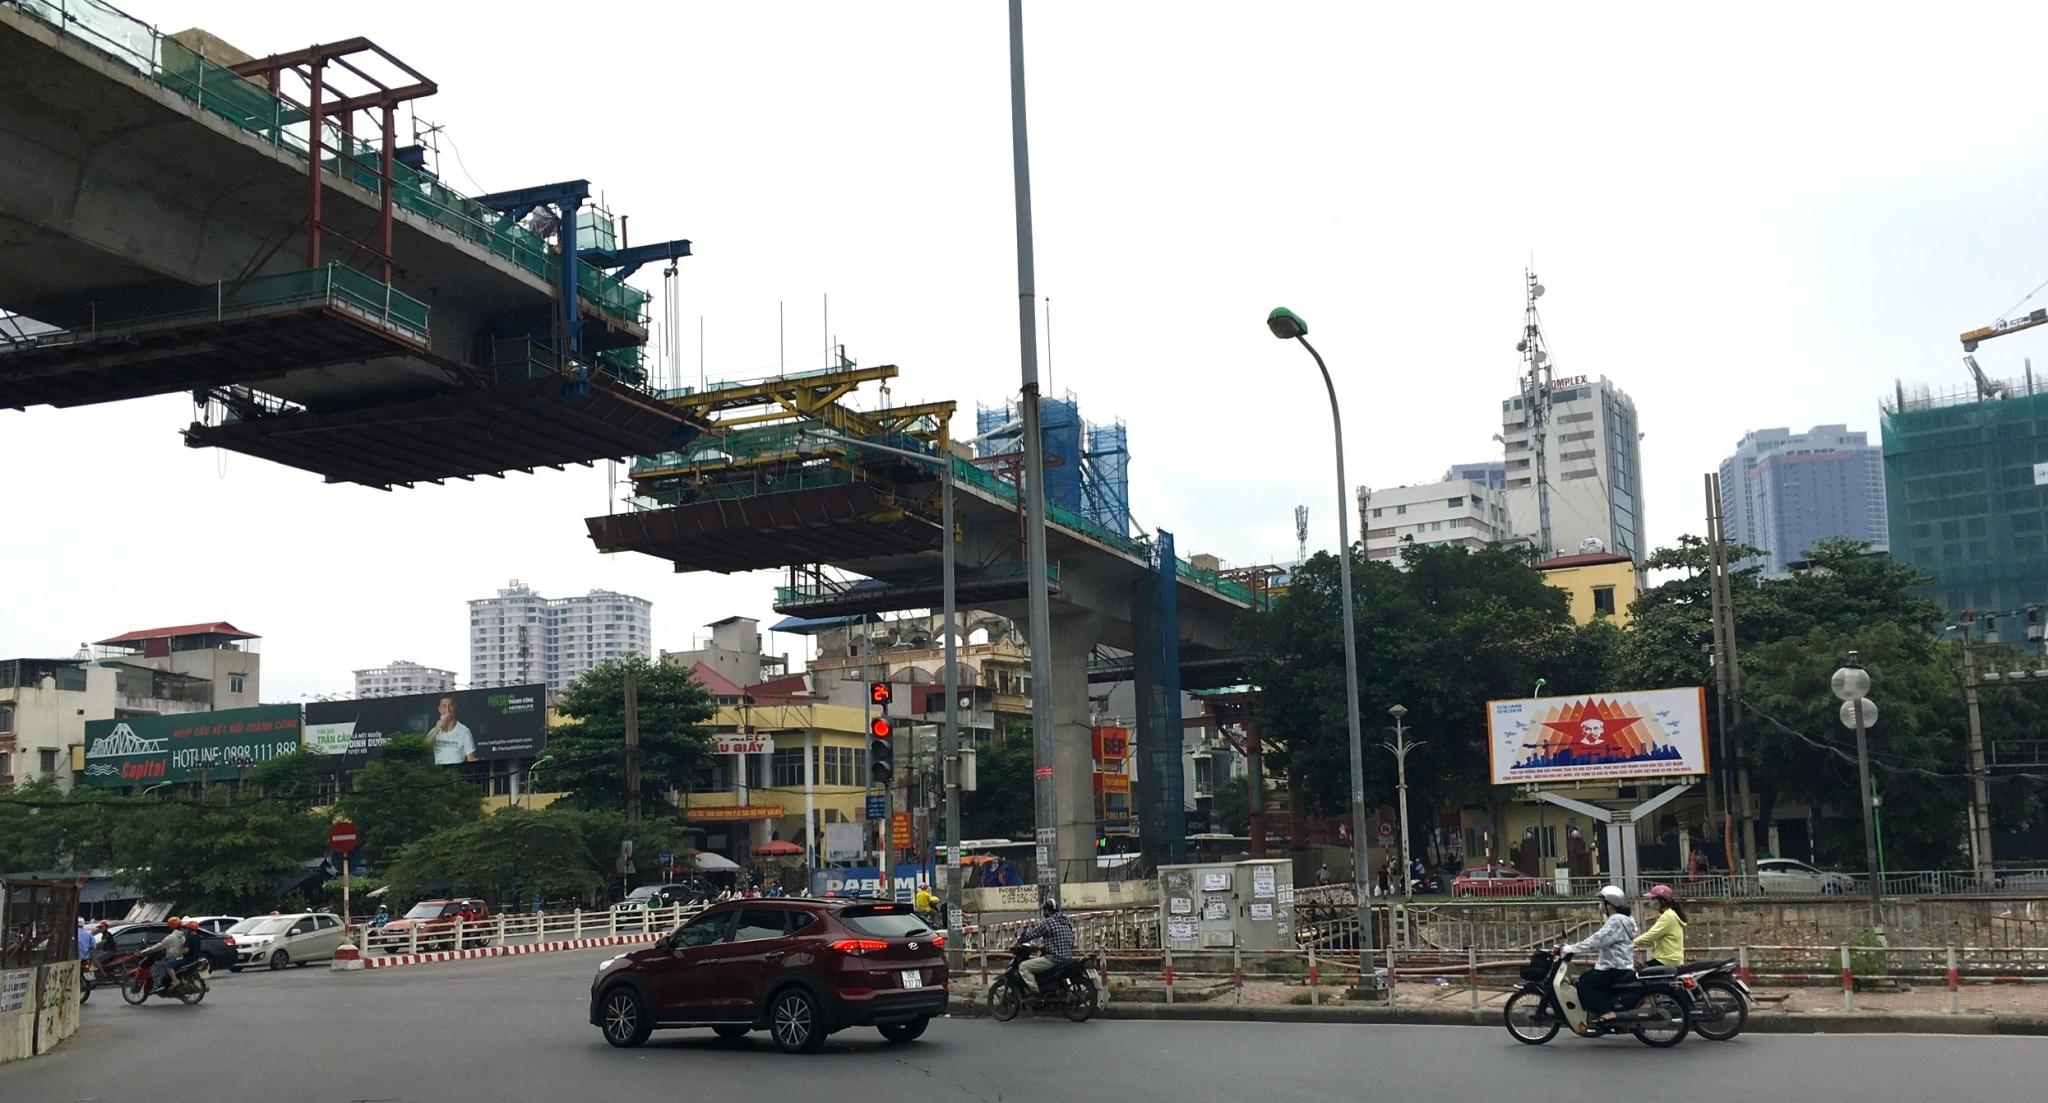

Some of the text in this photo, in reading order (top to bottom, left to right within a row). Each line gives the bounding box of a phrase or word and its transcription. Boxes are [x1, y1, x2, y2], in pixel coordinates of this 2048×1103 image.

[1551, 375, 1587, 389] OMPLEX
[733, 740, 764, 752] GIẤY
[121, 760, 168, 780] Capital
[827, 878, 914, 891] DAELM
